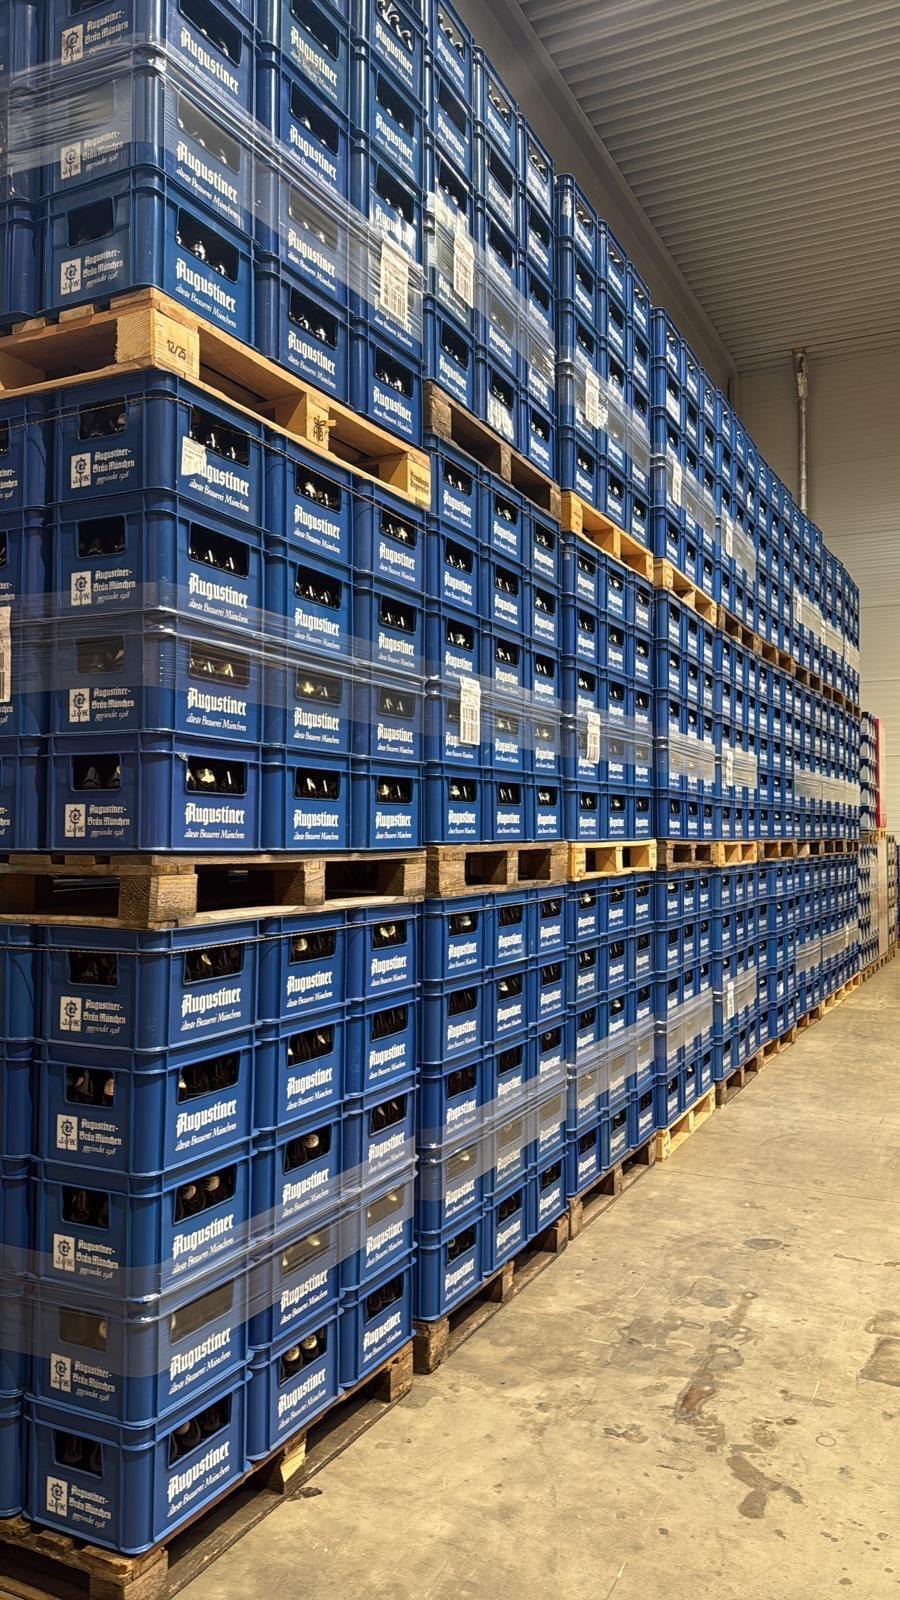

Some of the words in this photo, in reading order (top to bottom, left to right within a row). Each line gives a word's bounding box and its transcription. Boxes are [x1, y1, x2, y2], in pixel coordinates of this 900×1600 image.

[180, 27, 239, 95] Augustiner
[290, 26, 338, 86] Augustiner
[176, 141, 238, 204] Augustiner
[290, 125, 336, 181] Augustiner
[288, 228, 336, 279] Augustiner
[176, 258, 236, 314] Augustiner
[288, 330, 336, 376] Augustiner
[294, 504, 341, 540] Augustiner
[190, 572, 248, 608] Augustiner
[294, 608, 340, 637] Augustiner
[187, 687, 246, 716] Augustiner
[294, 706, 339, 731] Augustiner
[185, 802, 245, 825] Augustiner
[294, 809, 338, 829] Augustiner
[181, 987, 241, 1018] Augustiner
[287, 970, 332, 996] Augustiner
[286, 1067, 332, 1098] Augustiner
[176, 1099, 237, 1138] Augustiner
[283, 1168, 329, 1205] Augustiner
[172, 1214, 234, 1260] Augustiner
[280, 1269, 328, 1313] Augustiner
[170, 1328, 232, 1381] Augustiner
[278, 1368, 326, 1418] Augustiner
[167, 1440, 230, 1504] Augustiner
